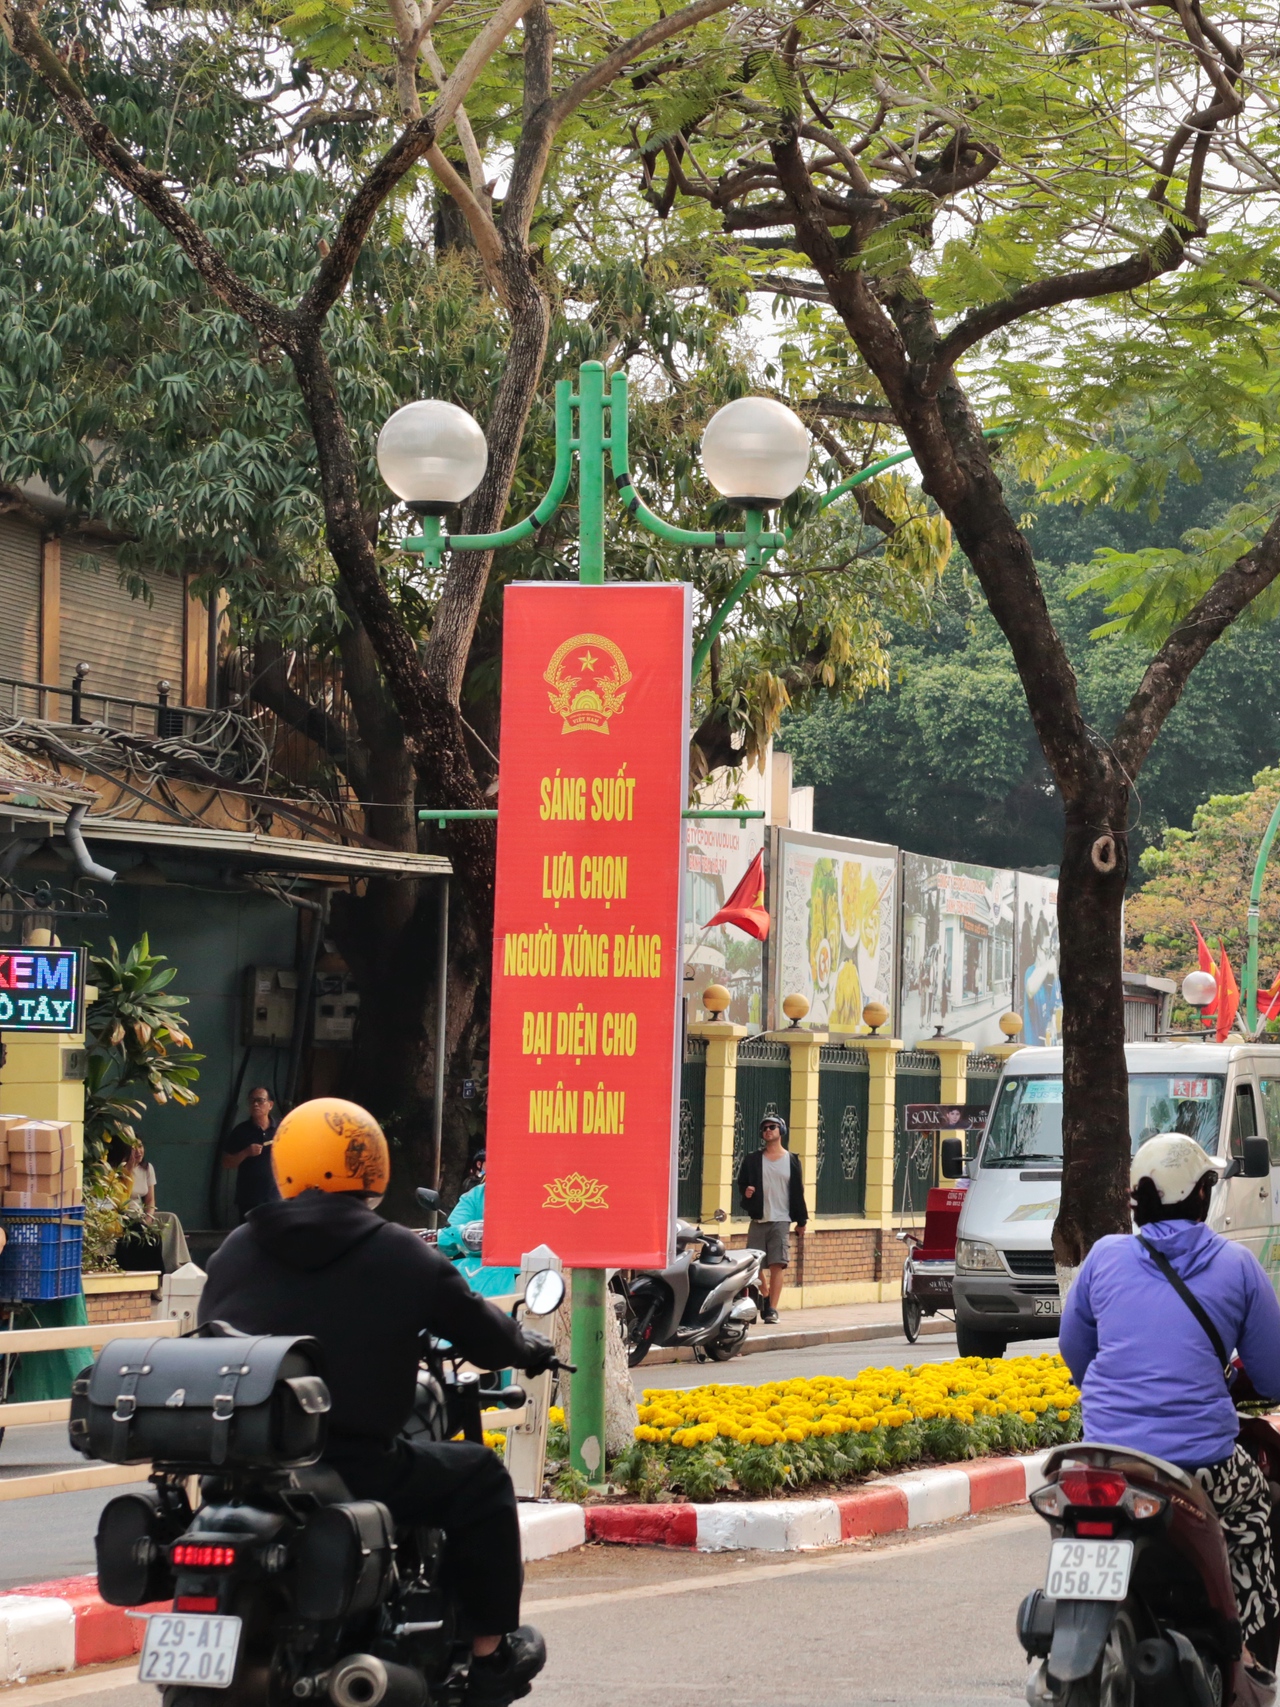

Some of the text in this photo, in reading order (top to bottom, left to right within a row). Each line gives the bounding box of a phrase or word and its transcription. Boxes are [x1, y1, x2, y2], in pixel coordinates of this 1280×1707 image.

[540, 762, 636, 821] SÁNG SUỐT
[542, 851, 628, 909] LỰA CHỌN
[504, 923, 661, 978] NGƯỜI XỨNG ĐÁNG
[18, 995, 71, 1021] TÂY
[522, 1002, 638, 1065] ĐẠI DIỆN CHO
[529, 1081, 625, 1134] NHÂN DÂN!
[1036, 1301, 1062, 1314] 29L
[1060, 1545, 1120, 1569] 29-B2
[1050, 1571, 1123, 1596] 058.75
[157, 1620, 224, 1648] 29-A1
[146, 1651, 226, 1681] 232.04
